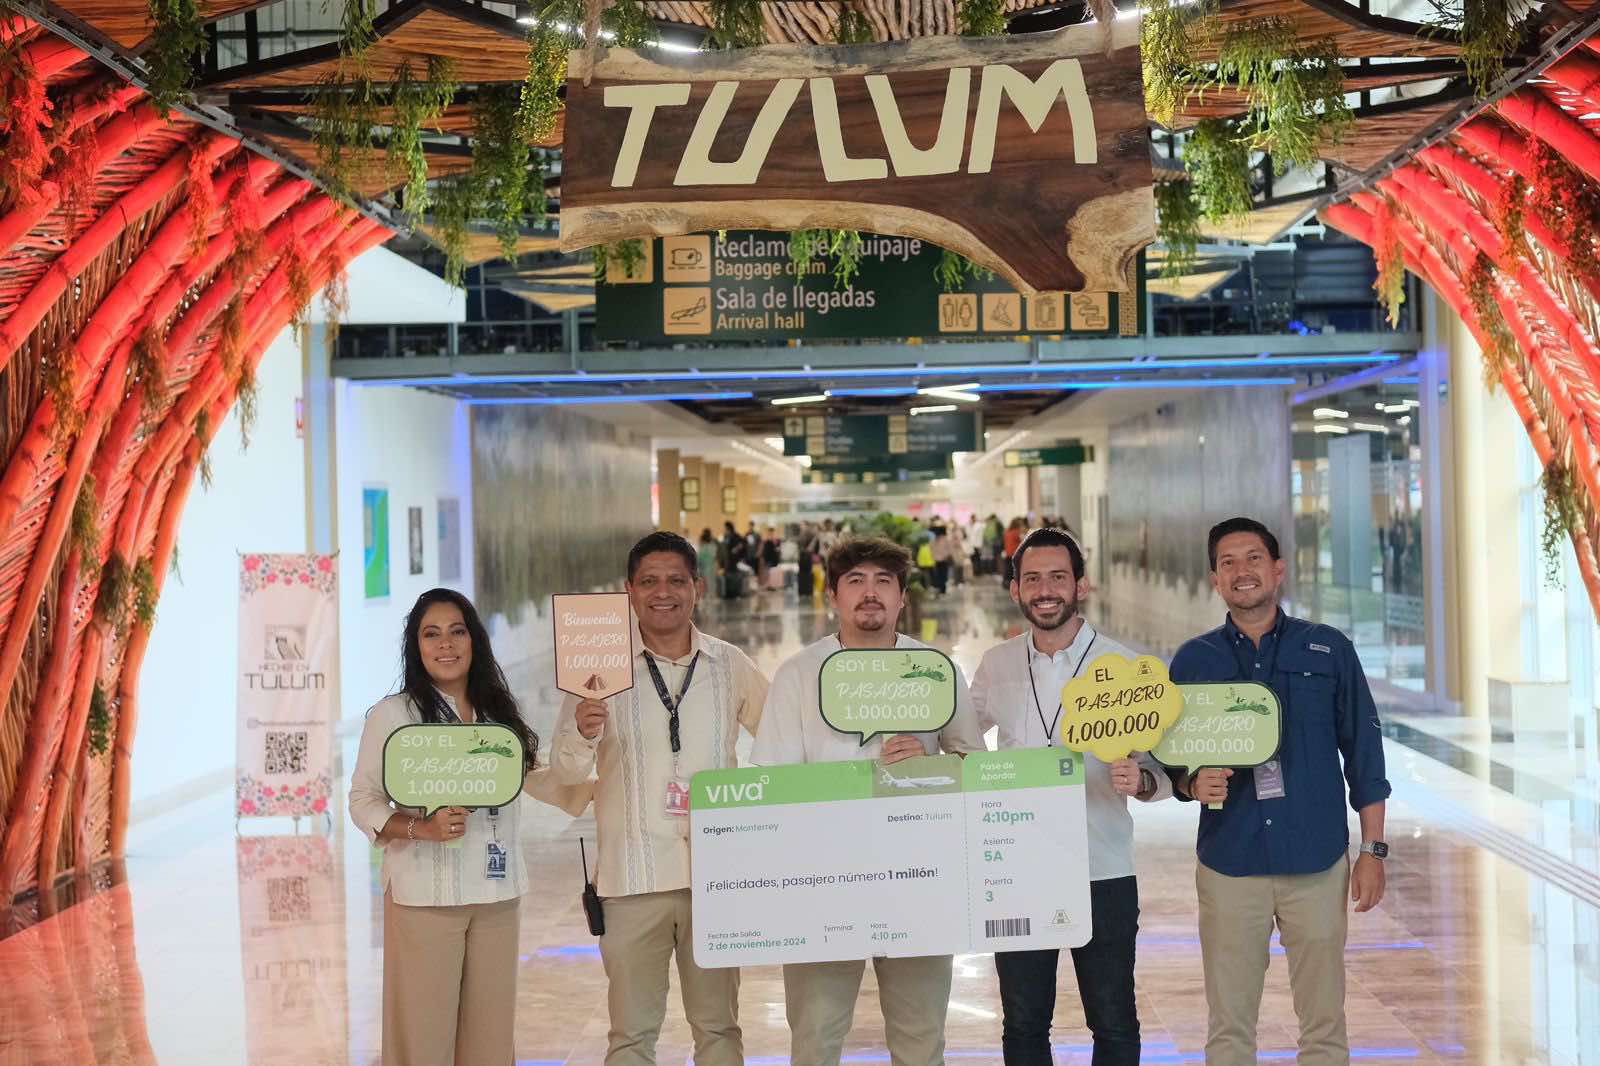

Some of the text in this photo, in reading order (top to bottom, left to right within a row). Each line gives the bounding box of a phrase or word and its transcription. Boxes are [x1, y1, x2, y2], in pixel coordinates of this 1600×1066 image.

[604, 59, 1097, 187] TULUM
[715, 259, 781, 281] Baggage
[716, 286, 876, 314] Sala de llegadas
[716, 311, 804, 329] Arrival hall
[562, 611, 622, 626] Bienvenido
[560, 632, 628, 648] PASAJERO
[836, 659, 889, 672] SOY EL
[244, 673, 326, 690] TULUM
[1095, 668, 1114, 682] EL
[835, 681, 931, 701] PASAJERO
[1075, 684, 1164, 712] PASAJERO
[1196, 692, 1214, 705] EL
[1067, 711, 1160, 744] 1,000,000
[1174, 715, 1255, 735] ASAJERO
[400, 735, 456, 748] SOY EL
[400, 757, 498, 775] PASAJERO
[407, 779, 497, 797] 1,000,000
[705, 782, 764, 803] viva
[981, 801, 1002, 809] Hora
[887, 813, 924, 823] Destino:
[982, 811, 1035, 826] 4:10pm
[703, 823, 780, 836] Origen: Monterrey
[983, 838, 1016, 846] Asiento
[984, 850, 1004, 862] 5A
[706, 866, 939, 894] ¡Felicidades, pasajero número 1 millón!
[984, 878, 1013, 887] Puerta
[984, 891, 994, 903] 3
[708, 936, 806, 951] 2 de noviembre 2024
[891, 932, 908, 943] pm
